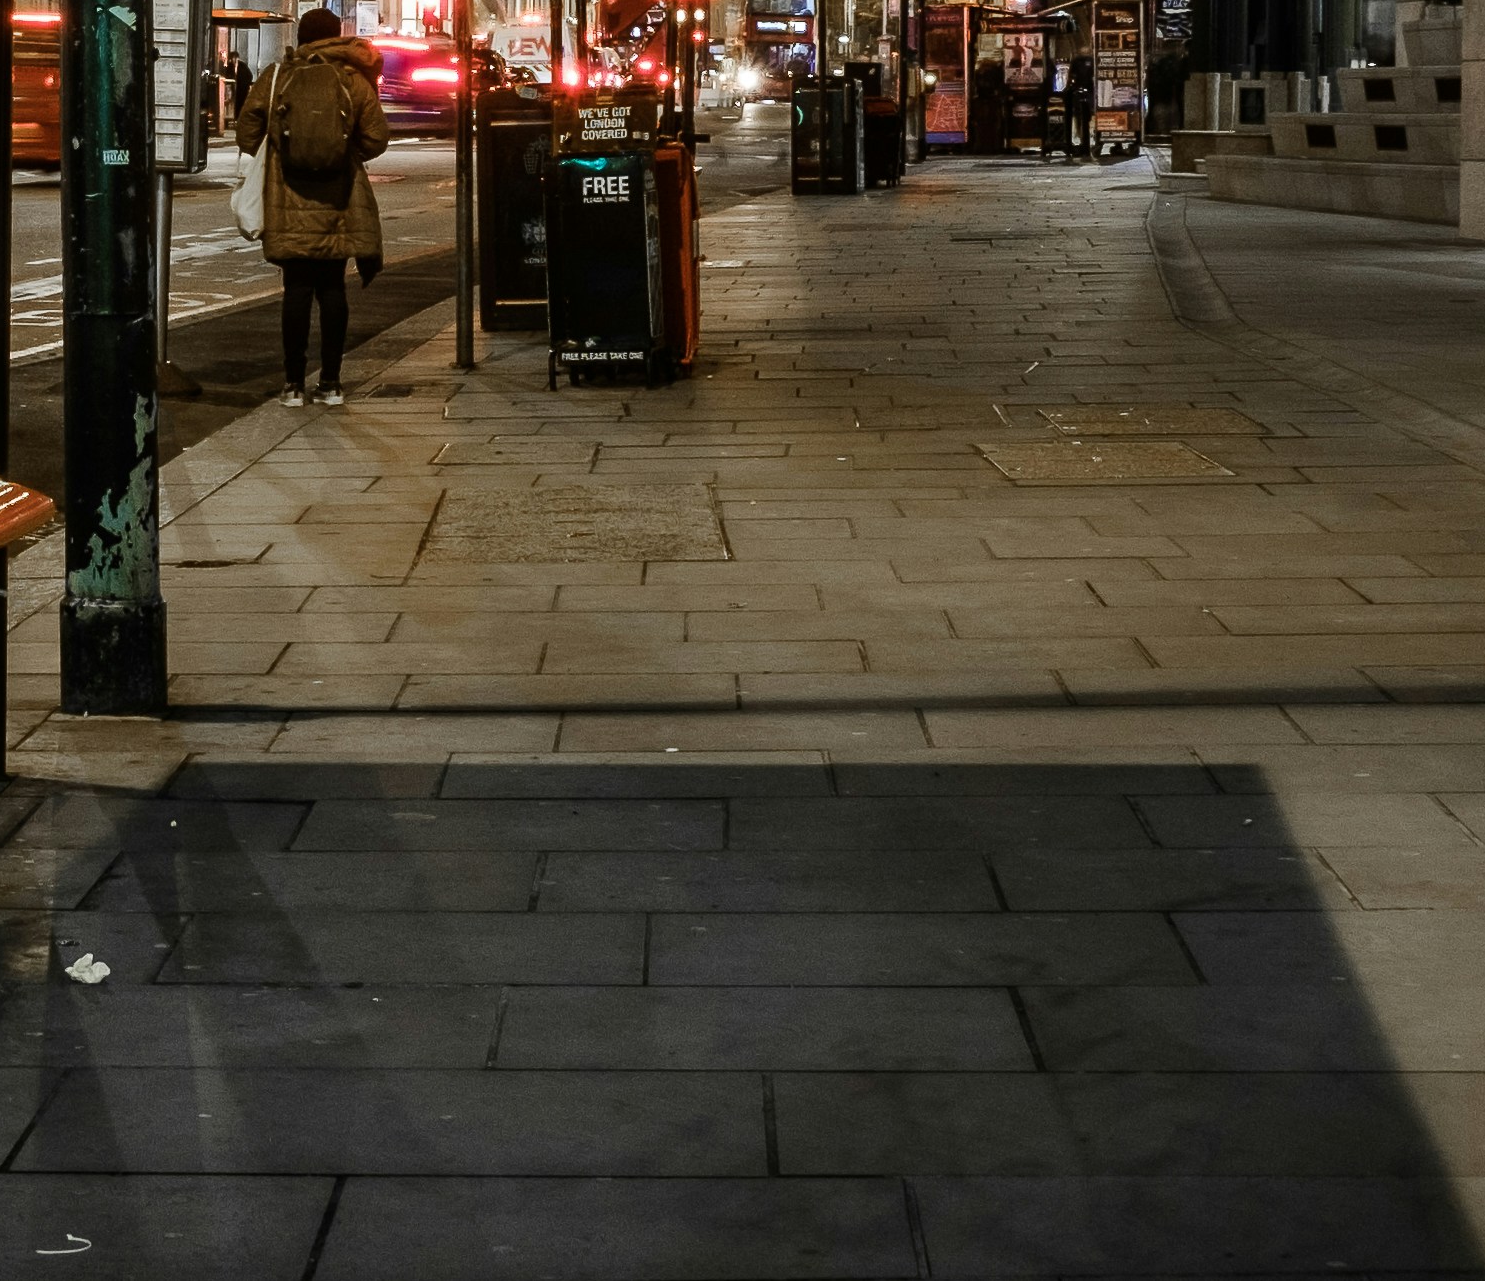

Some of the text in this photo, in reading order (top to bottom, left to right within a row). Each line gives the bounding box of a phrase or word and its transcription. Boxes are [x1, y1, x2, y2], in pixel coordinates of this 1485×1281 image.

[578, 105, 632, 119] WE'VE GOT
[584, 117, 625, 129] LONDON
[581, 128, 628, 140] COVERED
[582, 175, 631, 196] FREE
[561, 351, 644, 361] FREE PLEASE TAKE ONE
